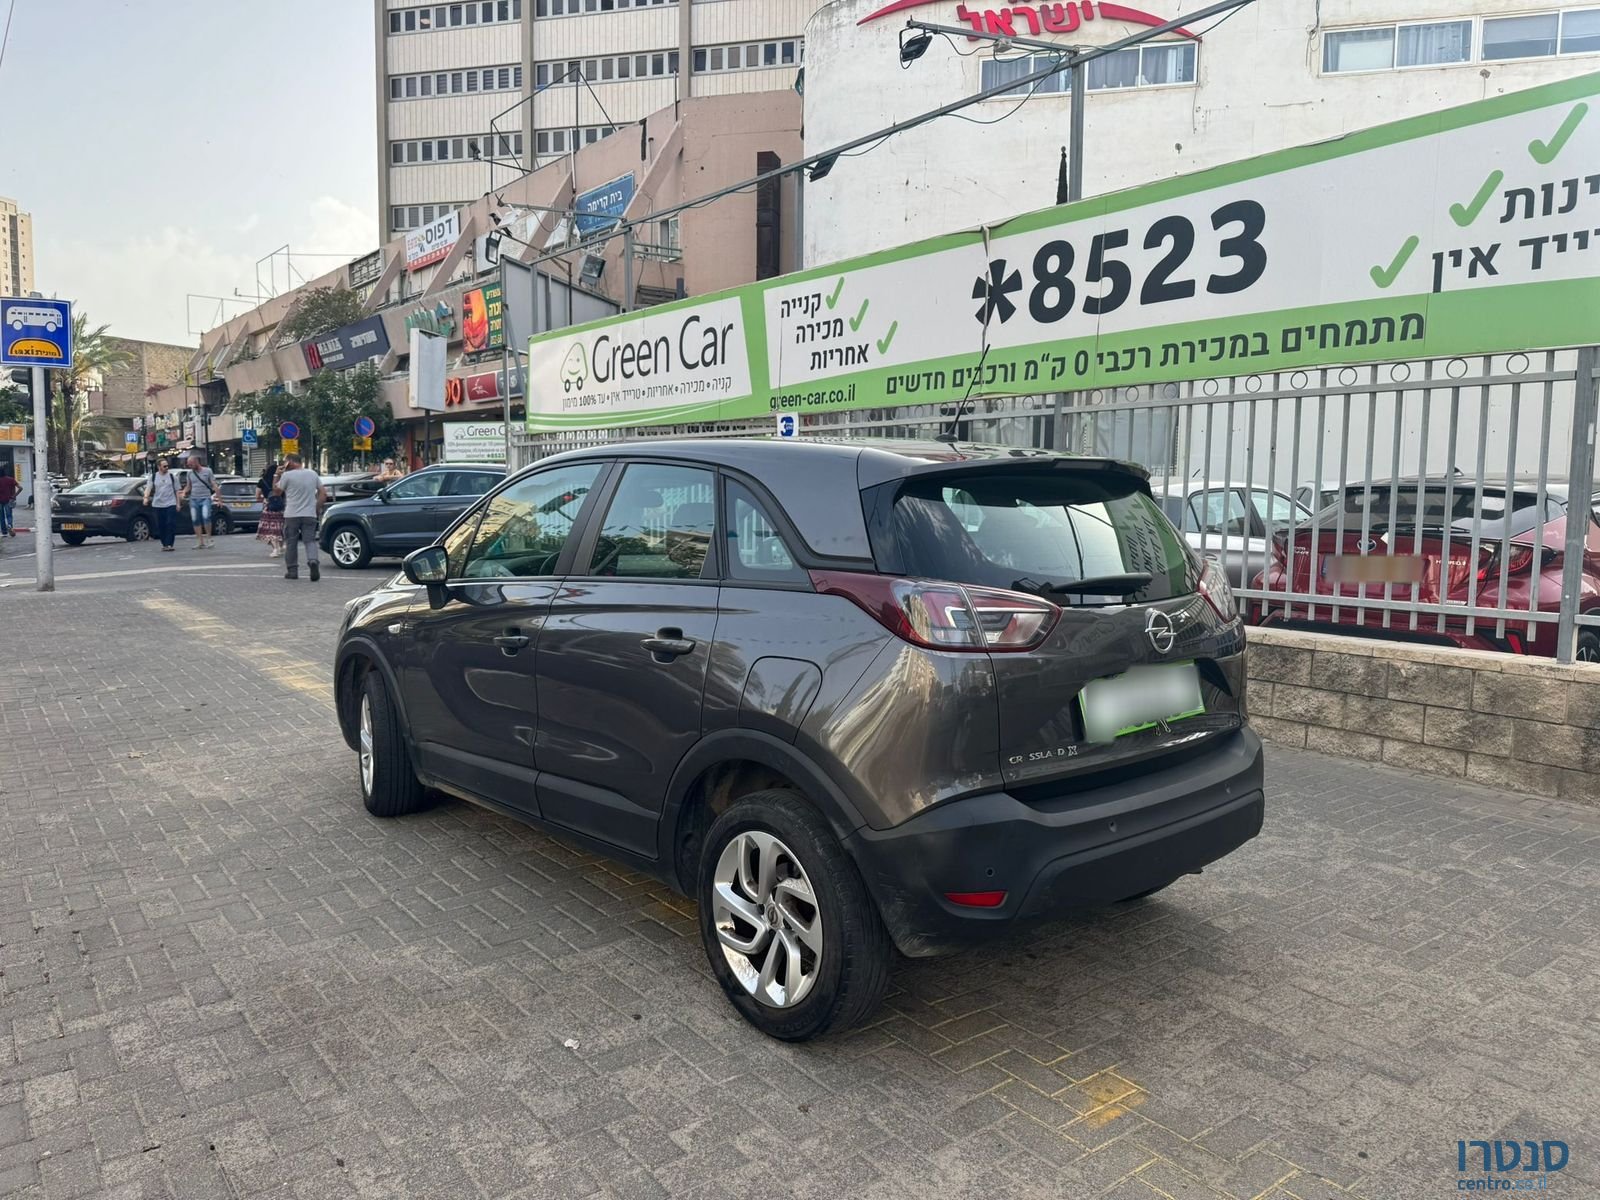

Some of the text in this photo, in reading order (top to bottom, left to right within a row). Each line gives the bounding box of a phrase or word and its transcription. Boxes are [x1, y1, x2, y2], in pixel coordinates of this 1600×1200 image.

[957, 1, 1094, 41] ישראל
[610, 191, 623, 204] בית
[425, 218, 453, 244] דפוס
[1432, 243, 1502, 293] אין
[780, 293, 821, 319] קנייה
[796, 318, 843, 344] מכירה
[1281, 312, 1424, 353] מתמחים
[592, 315, 734, 383] Green Car
[810, 343, 869, 370] אחריות
[1097, 346, 1151, 373] רכבי
[1160, 332, 1270, 367] במכירת
[952, 362, 1016, 388] ורכבים
[1073, 350, 1090, 376] 0
[622, 388, 641, 401] טרייד
[647, 384, 674, 398] אחריות
[680, 380, 705, 394] מכירה
[712, 376, 732, 392] קניה
[886, 371, 945, 394] חדשים
[579, 395, 597, 407] 100%
[597, 394, 606, 404] עד
[610, 391, 620, 405] אין
[770, 384, 856, 411] green-car.co.il
[467, 425, 497, 437] Green
